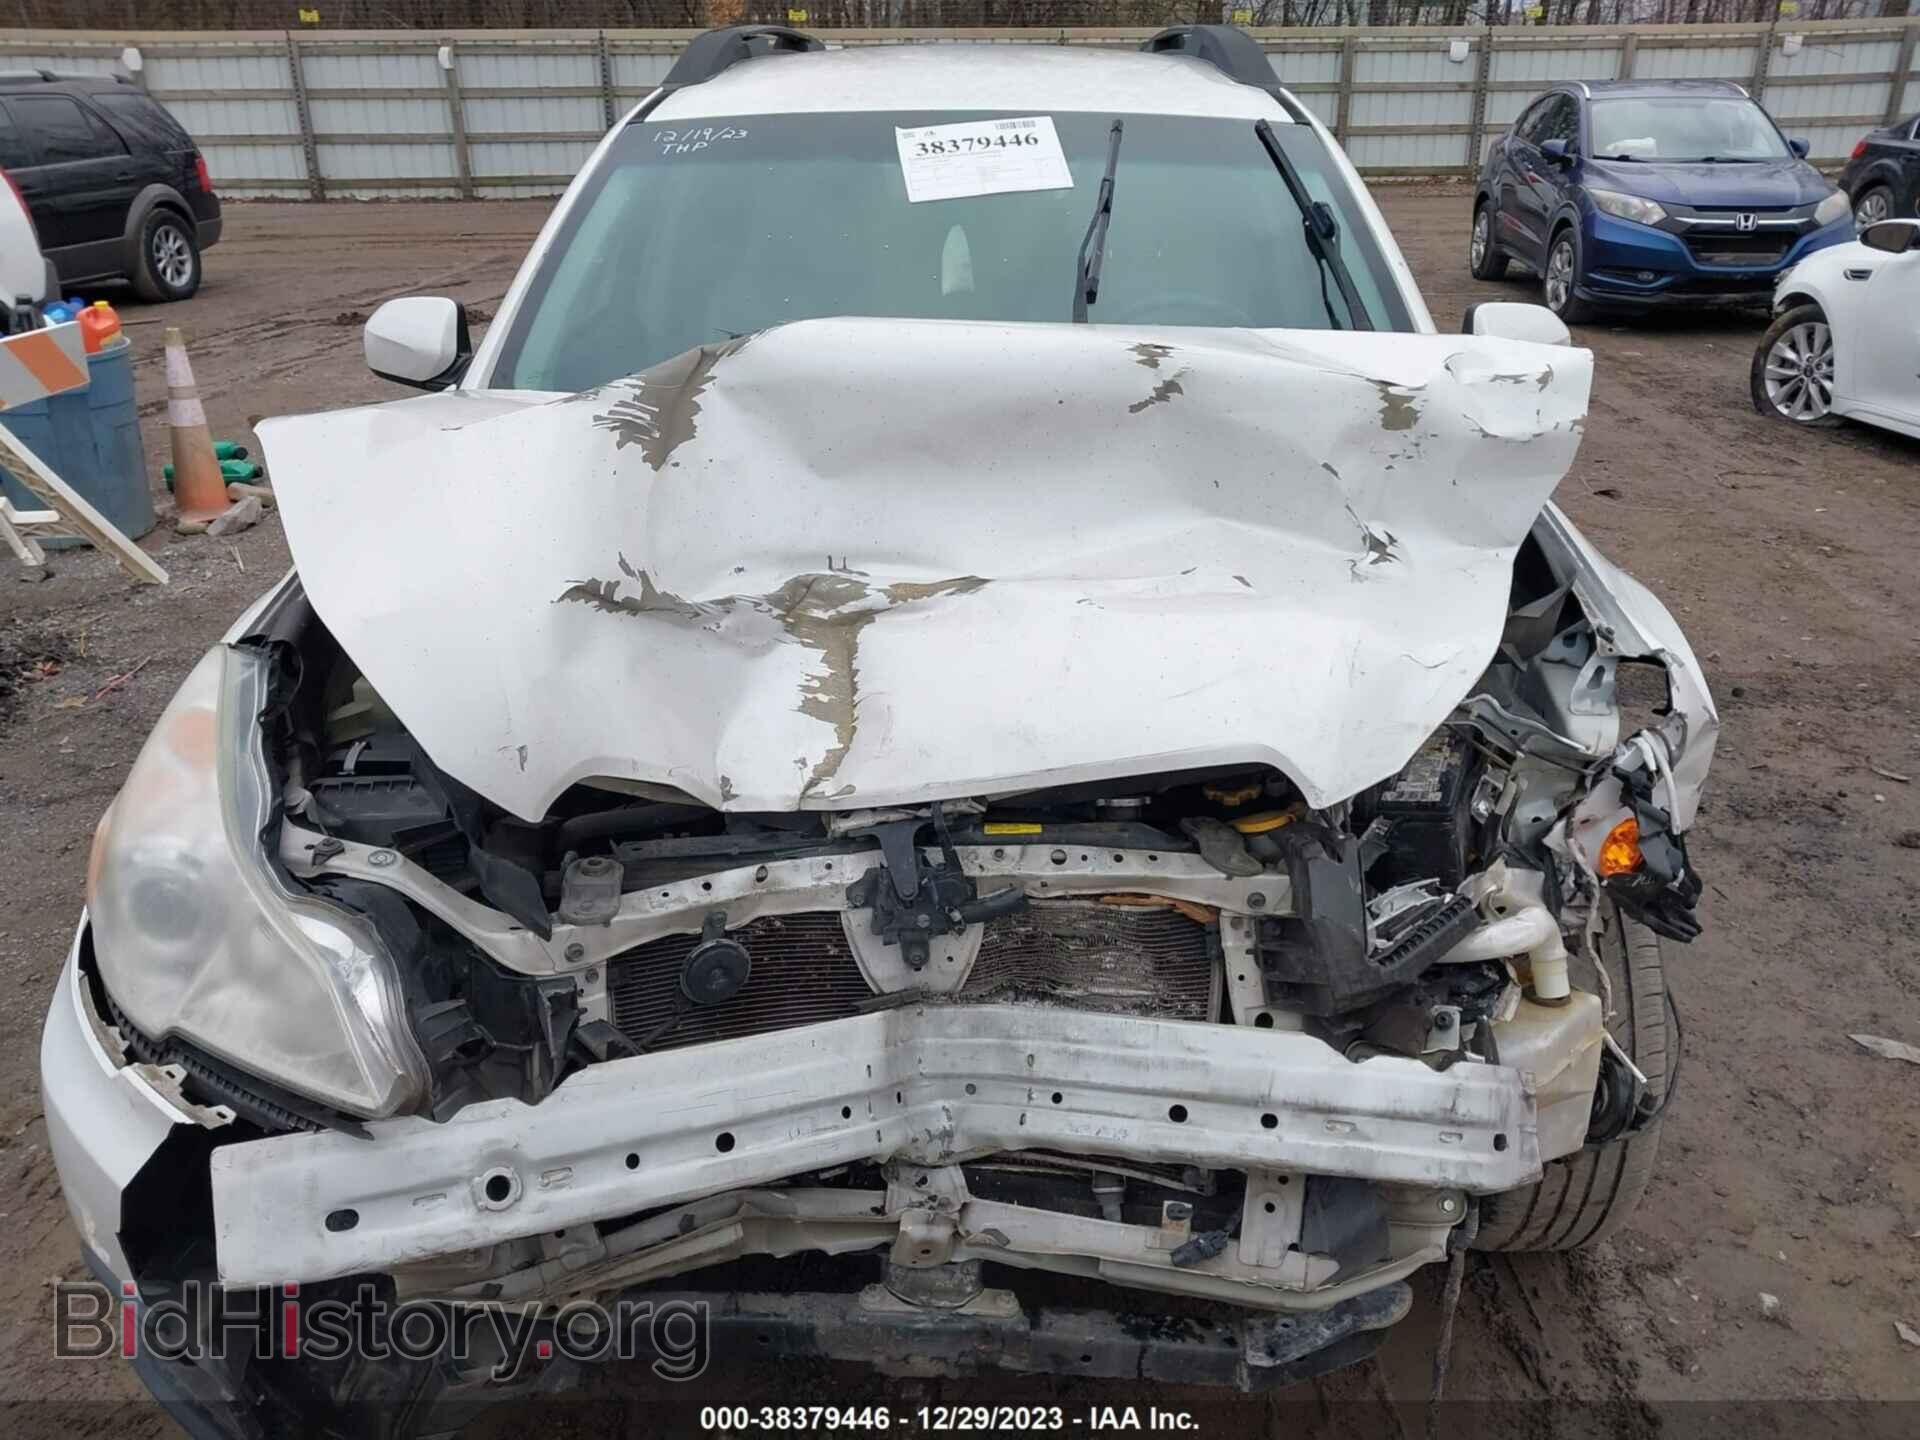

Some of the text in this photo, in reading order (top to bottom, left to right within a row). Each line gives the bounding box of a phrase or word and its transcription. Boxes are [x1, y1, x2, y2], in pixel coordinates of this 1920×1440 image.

[654, 127, 749, 143] 12/19/23
[663, 142, 709, 155] THP
[915, 132, 1040, 157] 38379446
